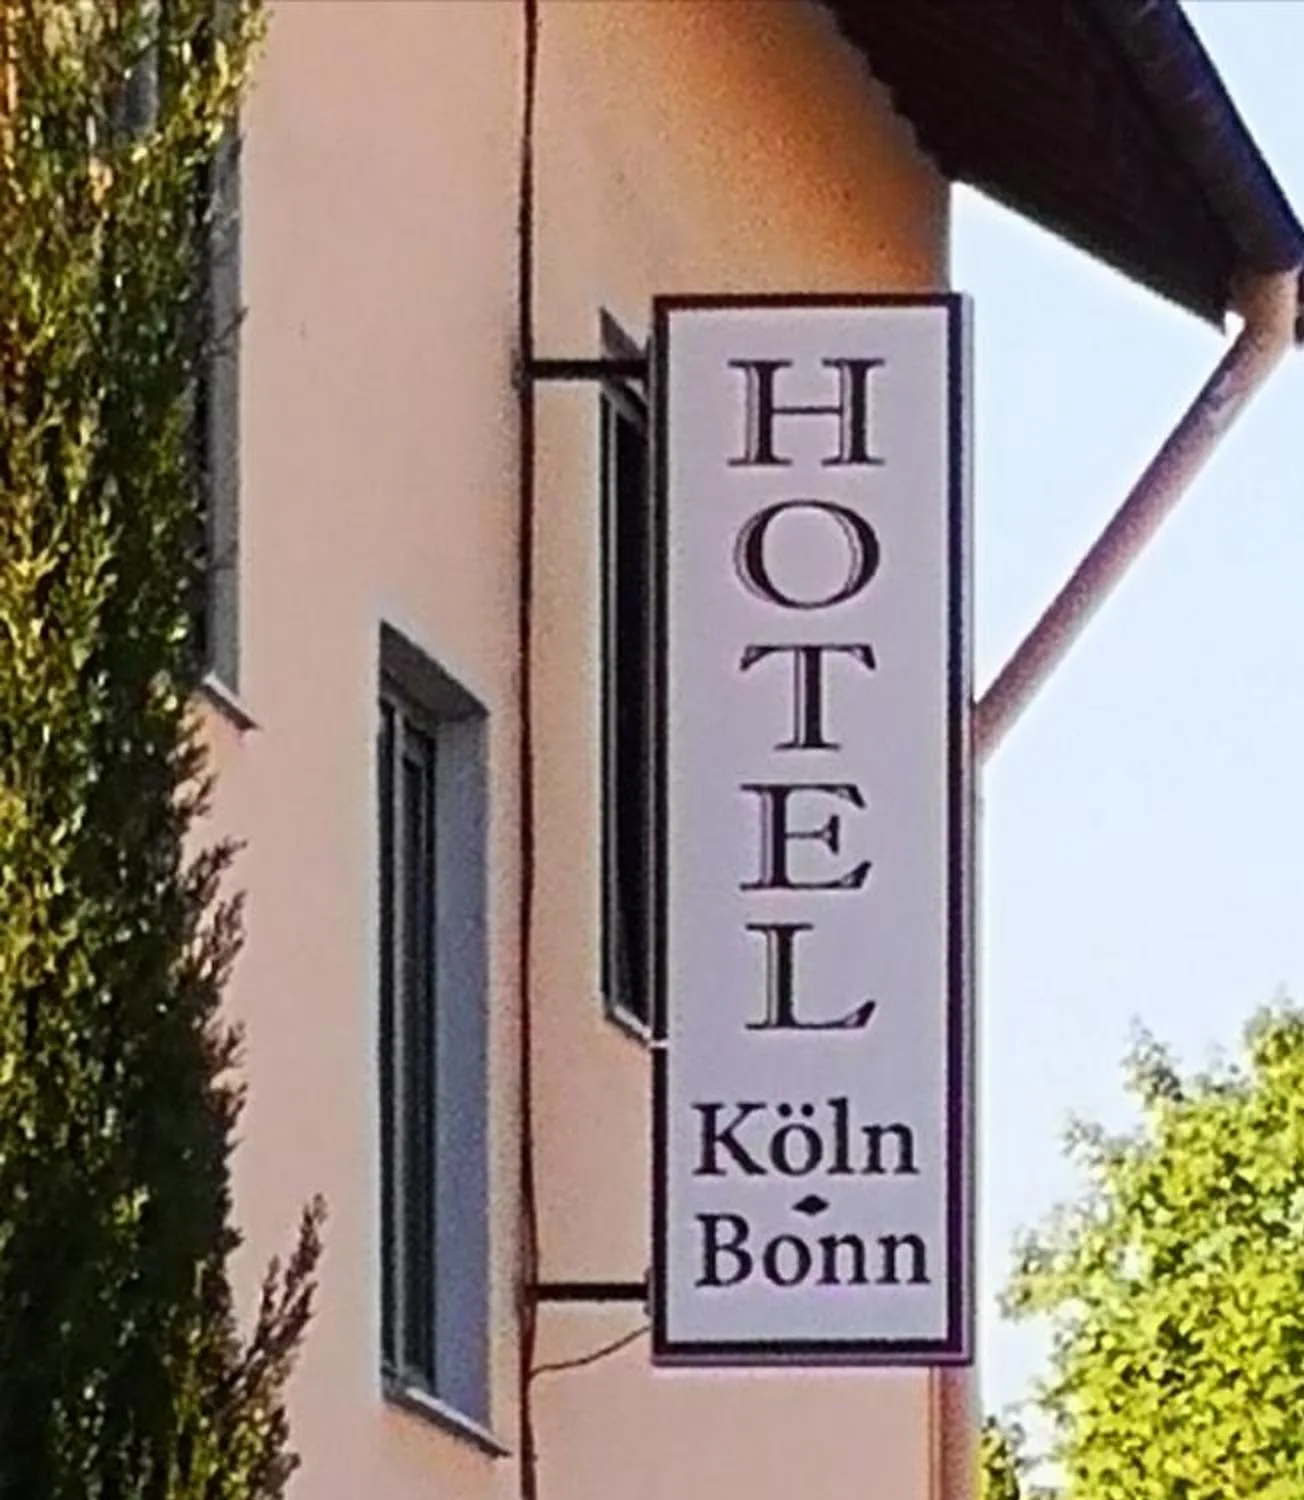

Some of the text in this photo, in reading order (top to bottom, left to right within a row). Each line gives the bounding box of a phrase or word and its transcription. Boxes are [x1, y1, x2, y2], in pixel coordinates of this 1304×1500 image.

[727, 357, 886, 1031] HOTEL
[691, 1096, 920, 1177] Köln
[694, 1212, 932, 1289] Bonn
